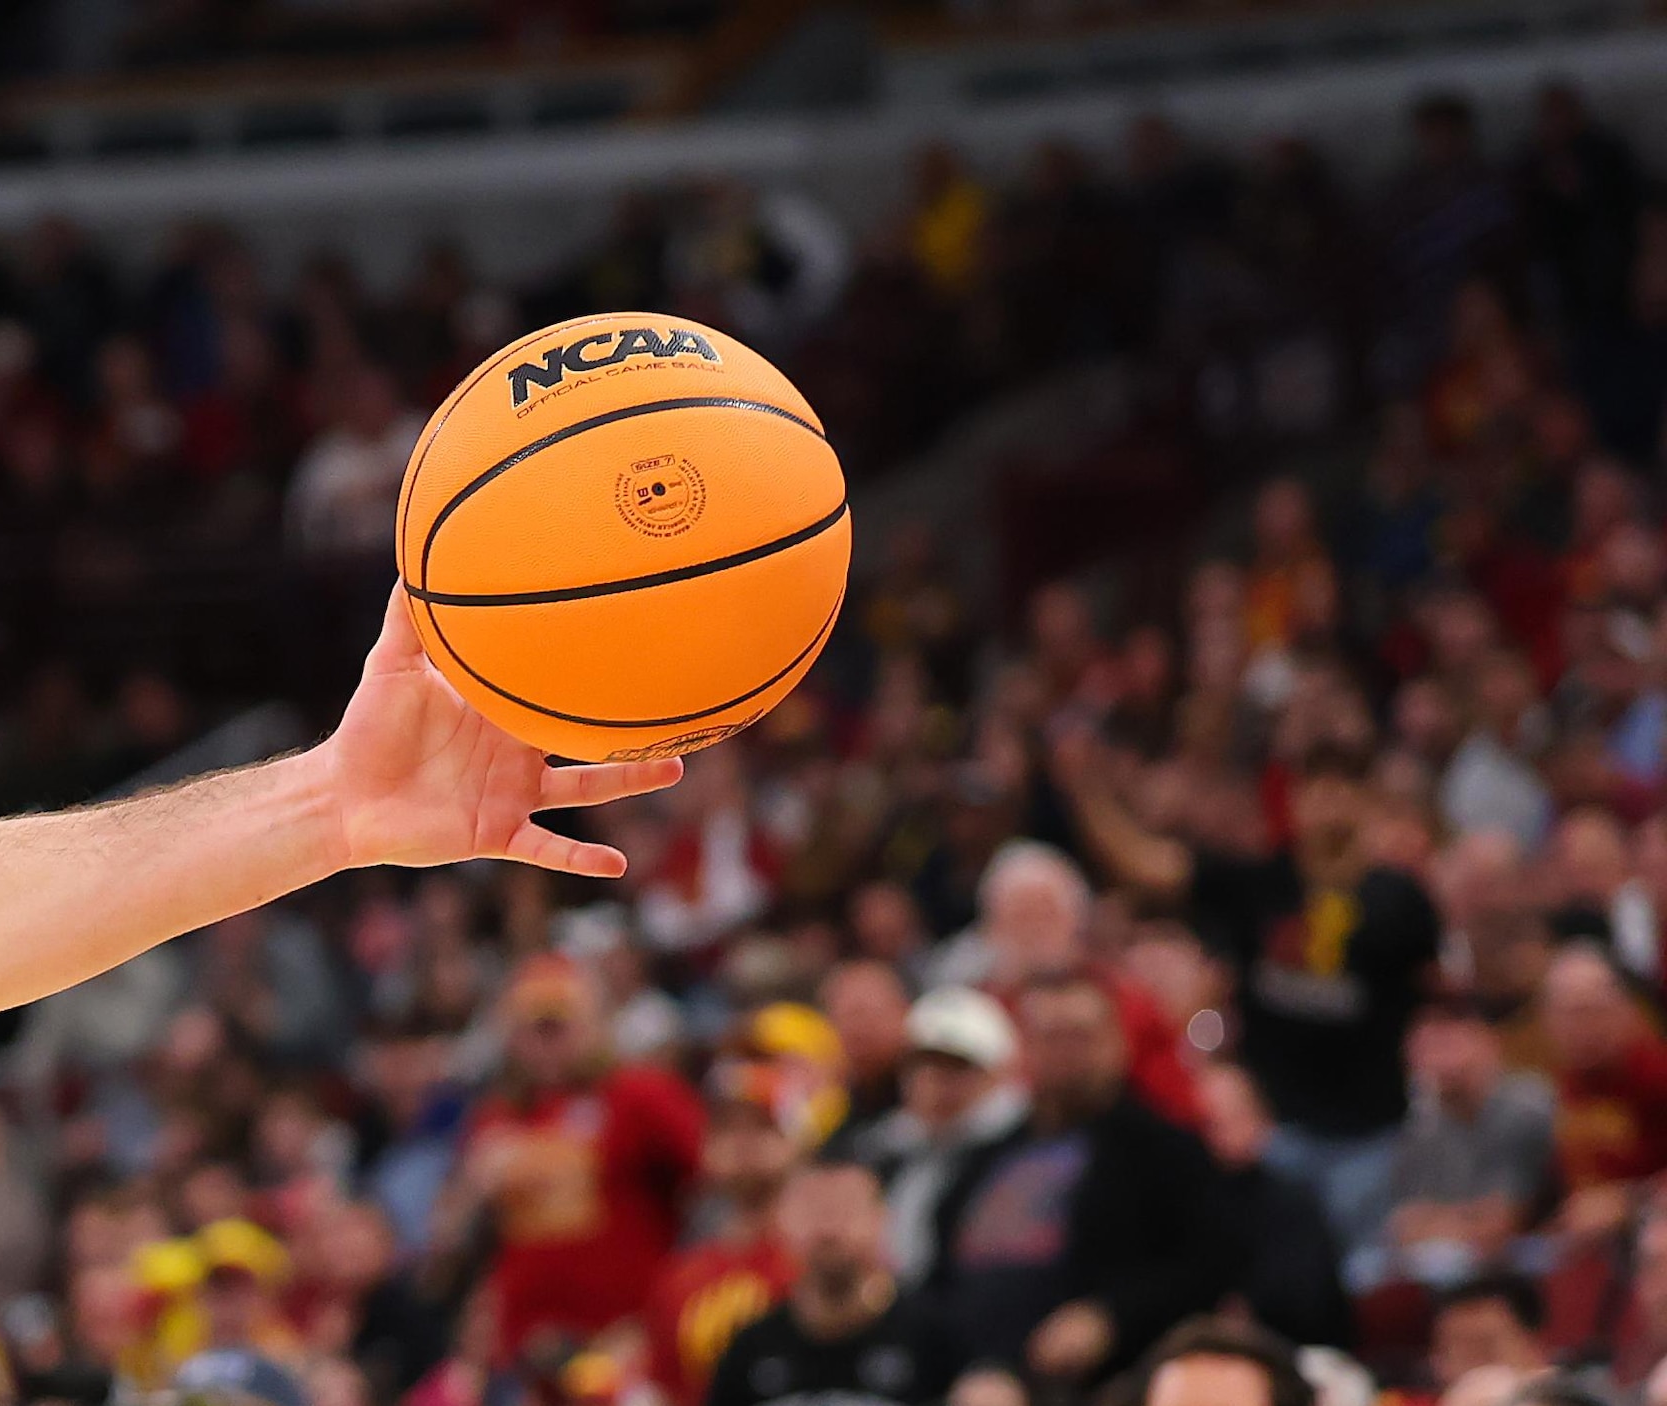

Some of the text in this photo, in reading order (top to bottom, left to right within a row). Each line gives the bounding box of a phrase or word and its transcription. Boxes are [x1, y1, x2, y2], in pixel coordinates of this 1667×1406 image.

[507, 327, 721, 408] NCAA
[517, 360, 722, 419] OFFICIAL GAME BALL
